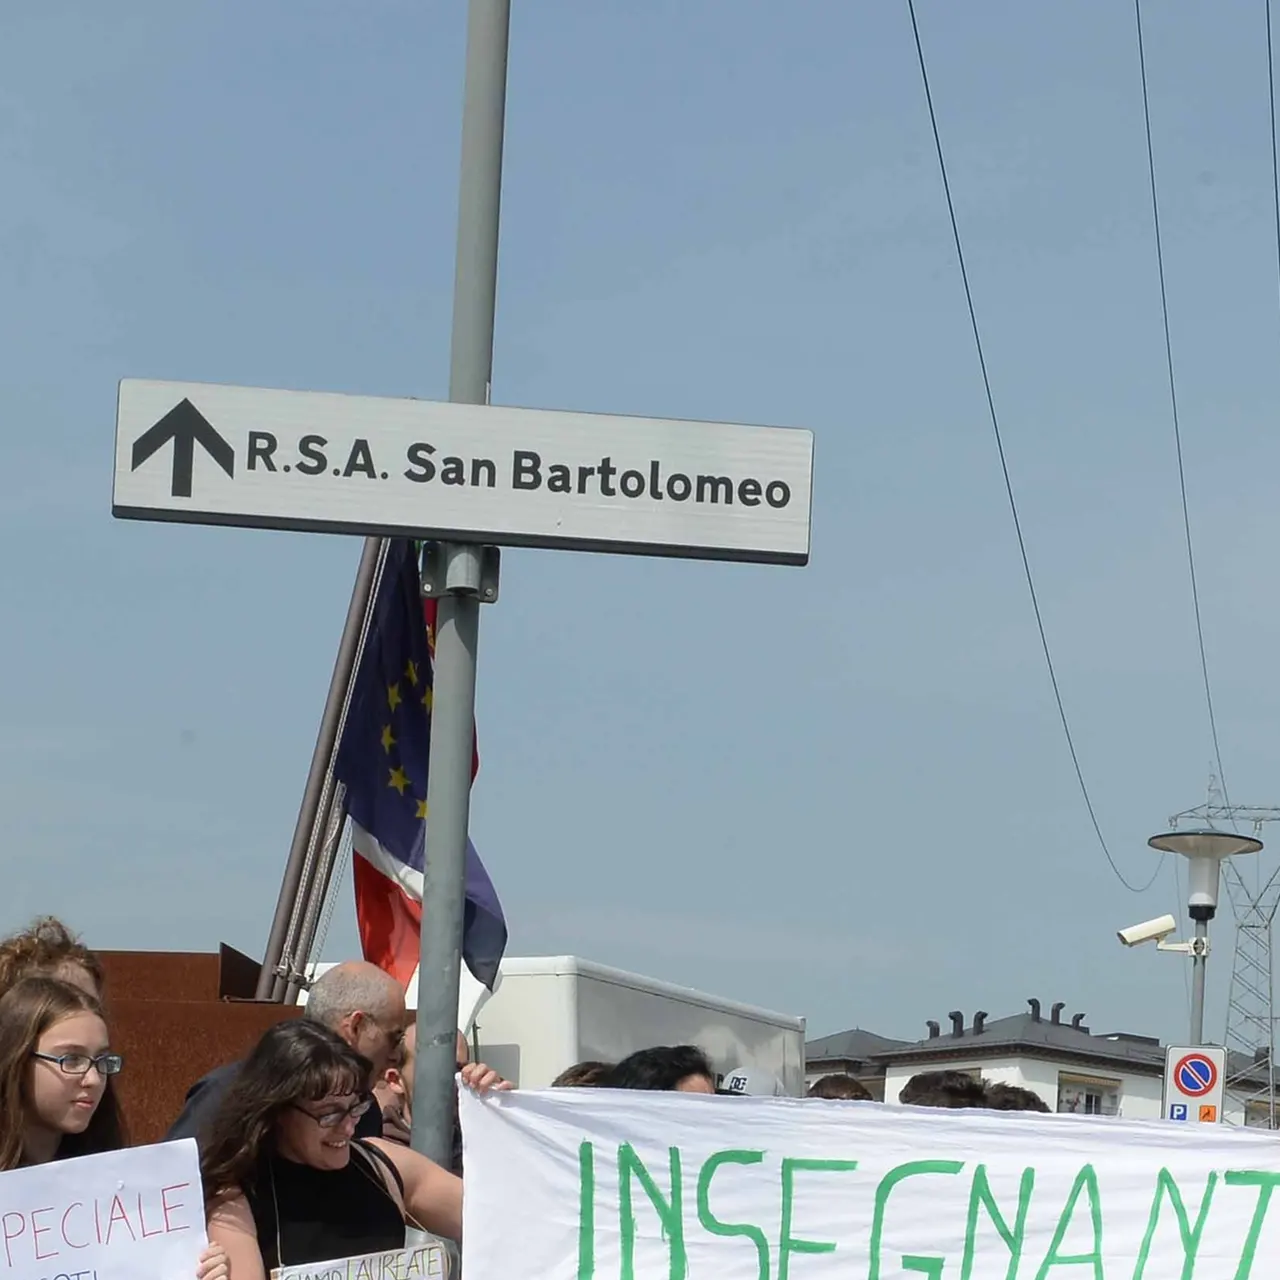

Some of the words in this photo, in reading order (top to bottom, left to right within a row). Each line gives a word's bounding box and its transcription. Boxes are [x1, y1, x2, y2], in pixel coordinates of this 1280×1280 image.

[247, 430, 388, 481] R.S.A.
[404, 442, 497, 489] San
[512, 450, 792, 509] Bartolomeo
